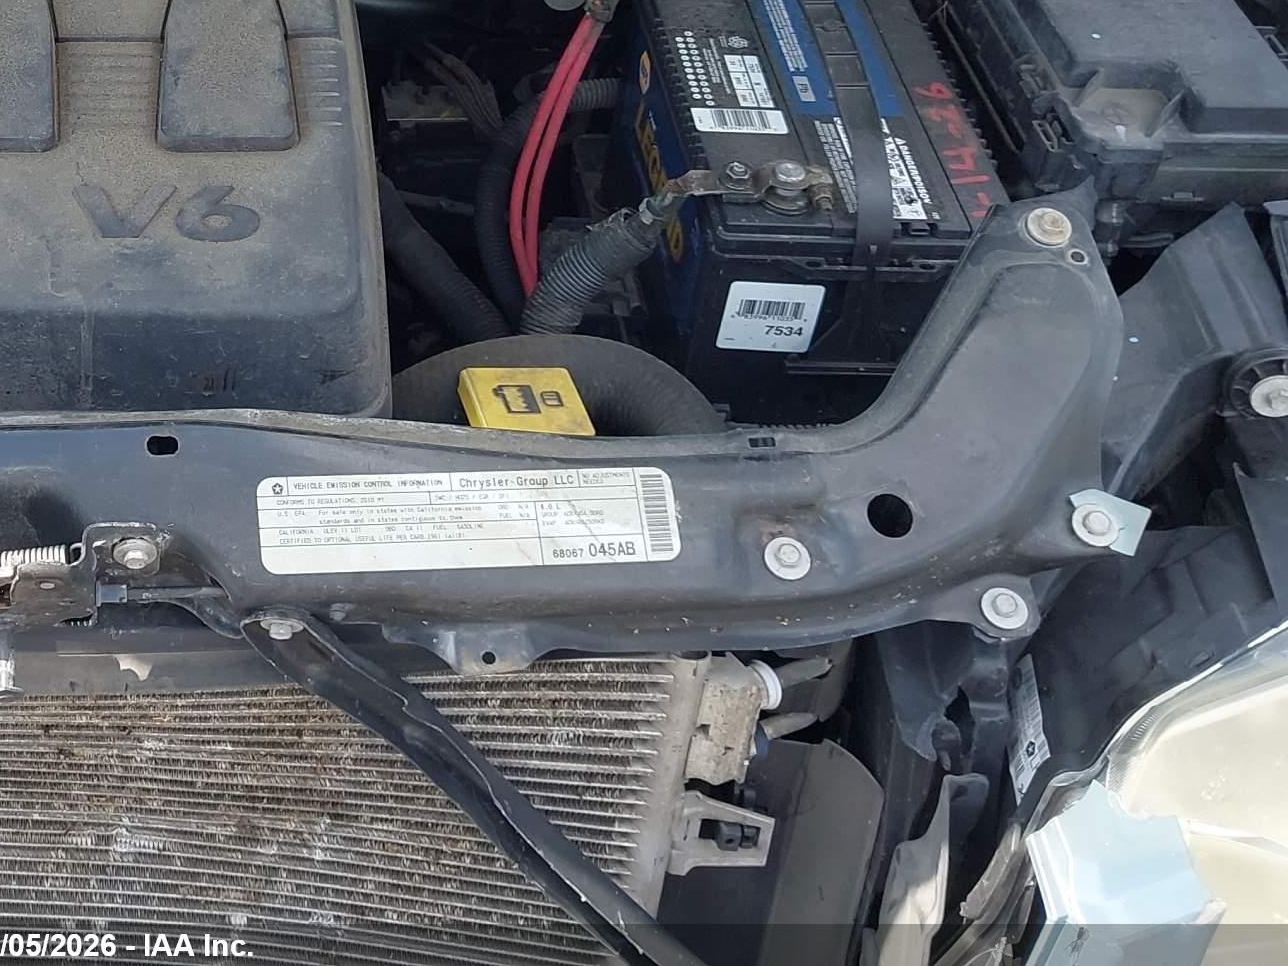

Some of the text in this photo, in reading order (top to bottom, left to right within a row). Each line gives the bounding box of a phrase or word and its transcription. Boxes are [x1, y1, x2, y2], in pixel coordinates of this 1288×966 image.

[73, 182, 261, 242] V6
[765, 325, 803, 336] 7534
[293, 478, 443, 490] VEHICLE EMISSION CONTROL INFORMATION
[459, 474, 574, 491] Chrysler Group LLC
[552, 541, 636, 559] 68067 045AB
